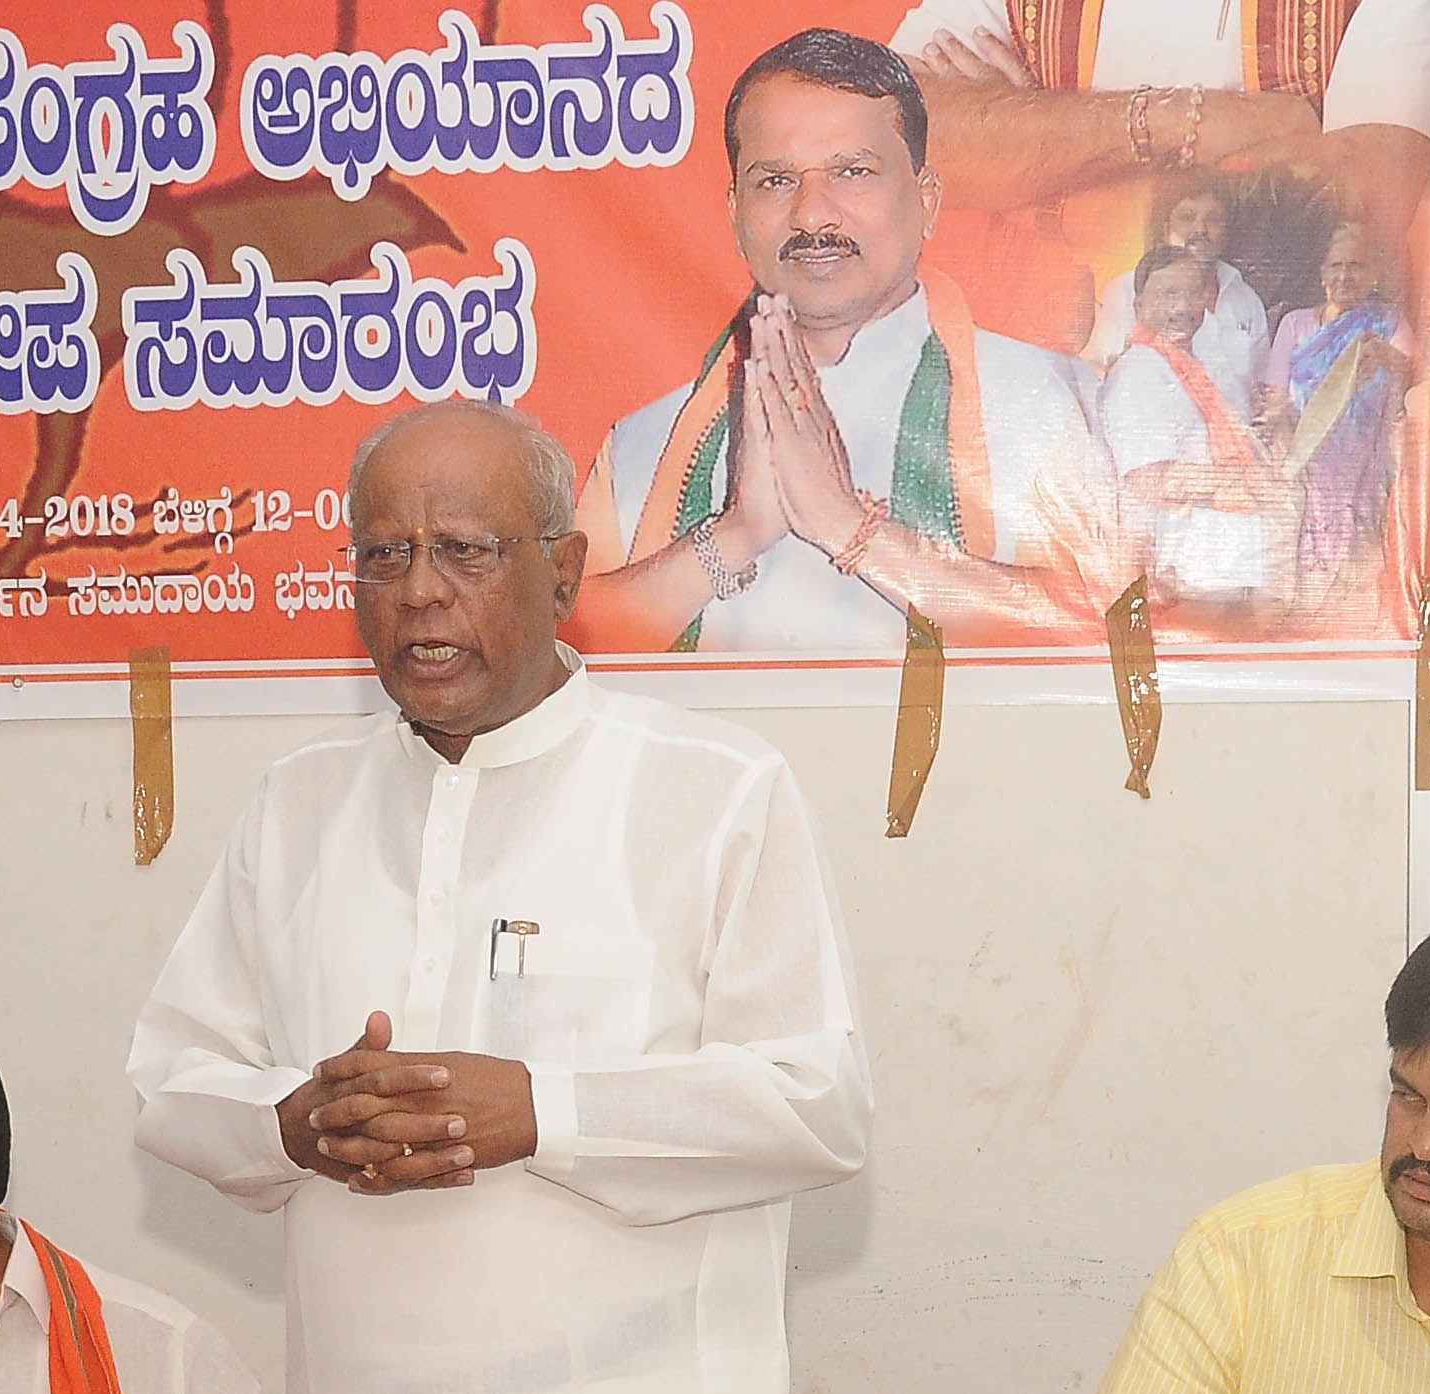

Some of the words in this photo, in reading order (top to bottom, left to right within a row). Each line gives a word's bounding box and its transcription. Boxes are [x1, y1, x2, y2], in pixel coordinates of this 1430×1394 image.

[252, 12, 682, 188] ಅಭಿಯಾನದ
[134, 250, 525, 405] ಸಮಾರಂಭ
[67, 563, 255, 616] ಸಮುದಾಯ
